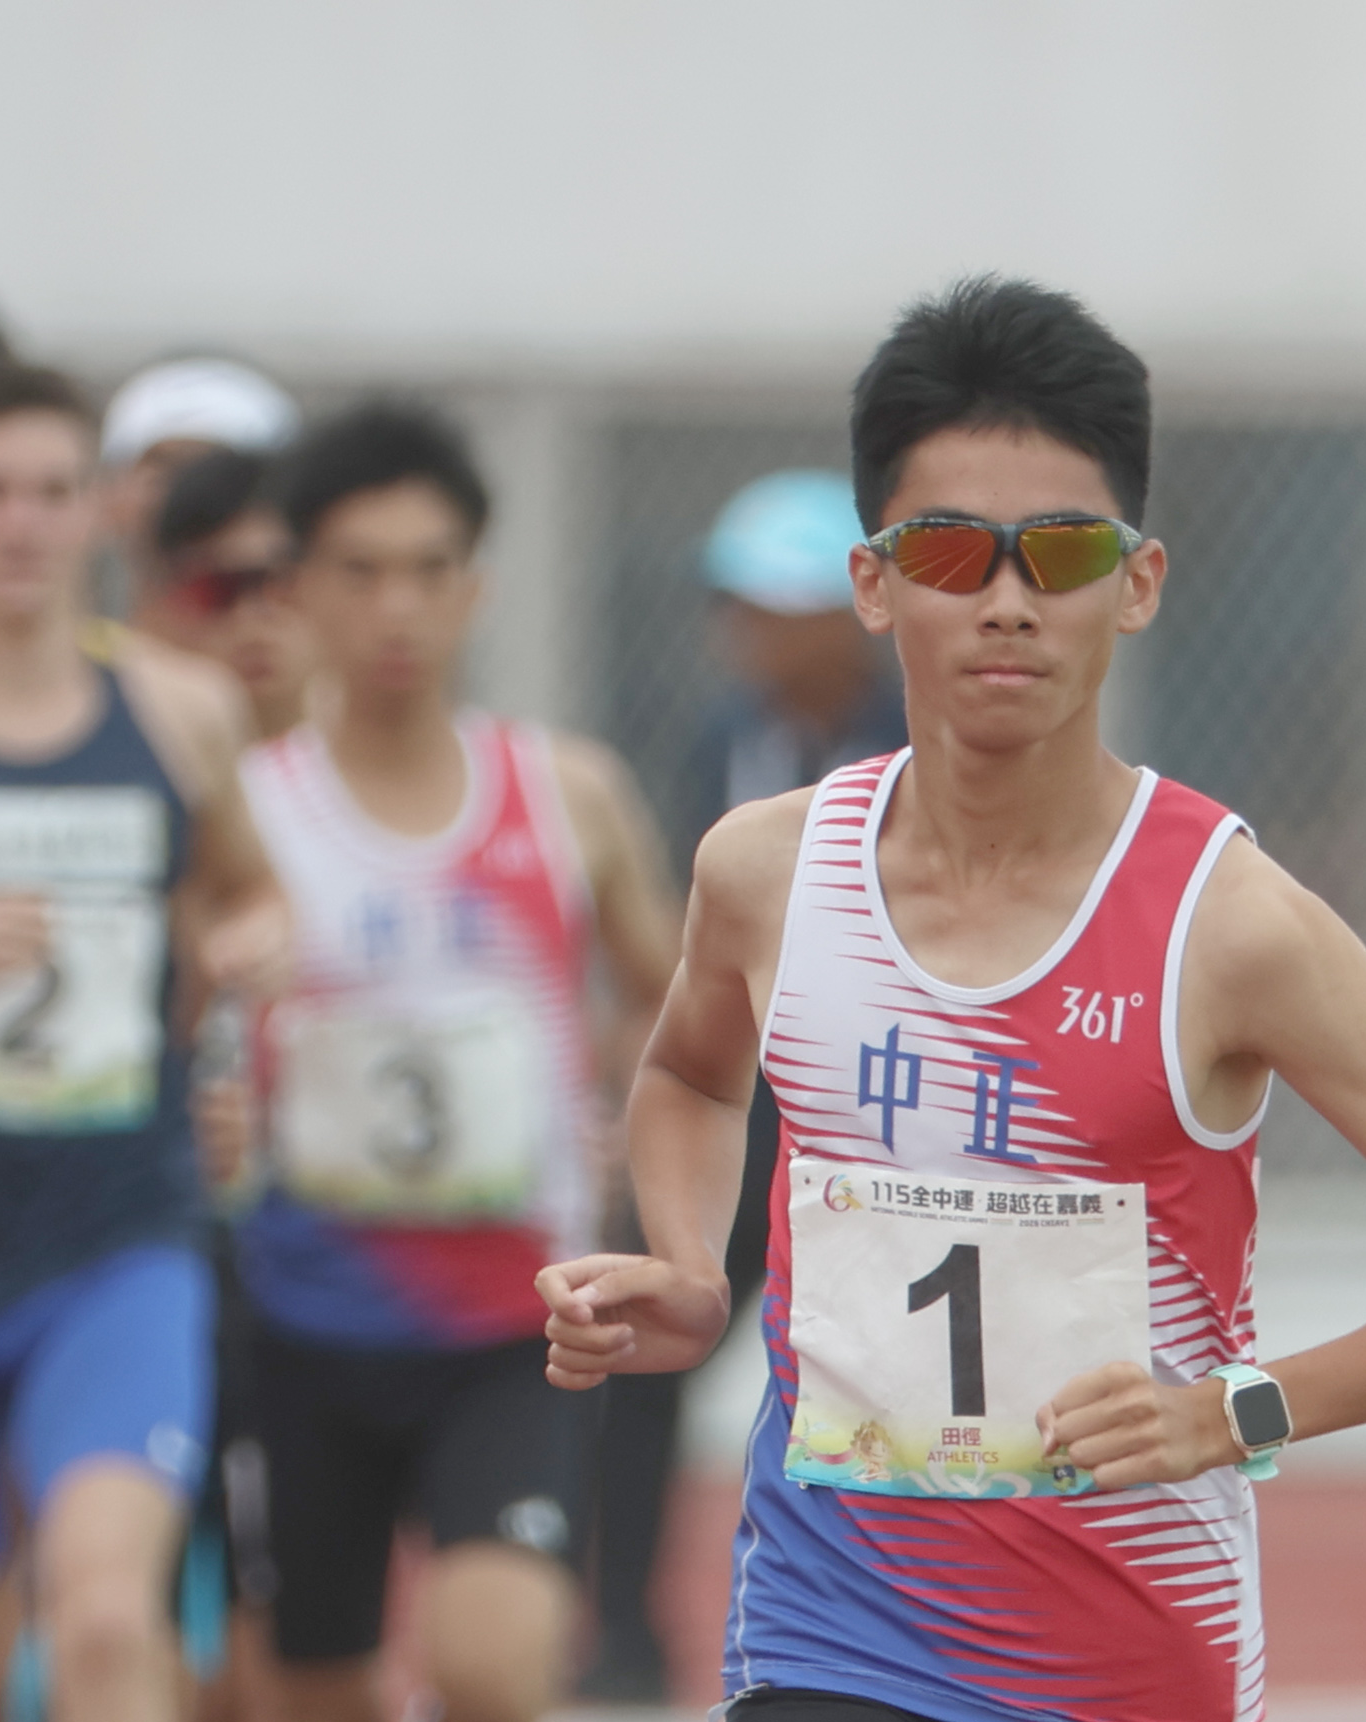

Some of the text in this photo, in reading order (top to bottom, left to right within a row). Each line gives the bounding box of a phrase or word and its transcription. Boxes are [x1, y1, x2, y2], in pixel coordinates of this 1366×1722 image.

[365, 1048, 460, 1180] 3
[858, 1021, 1041, 1164] 中正
[871, 1181, 1105, 1215] 115全中運 超越在嘉義
[907, 1243, 987, 1417] 1
[926, 1450, 1000, 1464] ATHLETICS
[941, 1427, 982, 1446] 田徑
